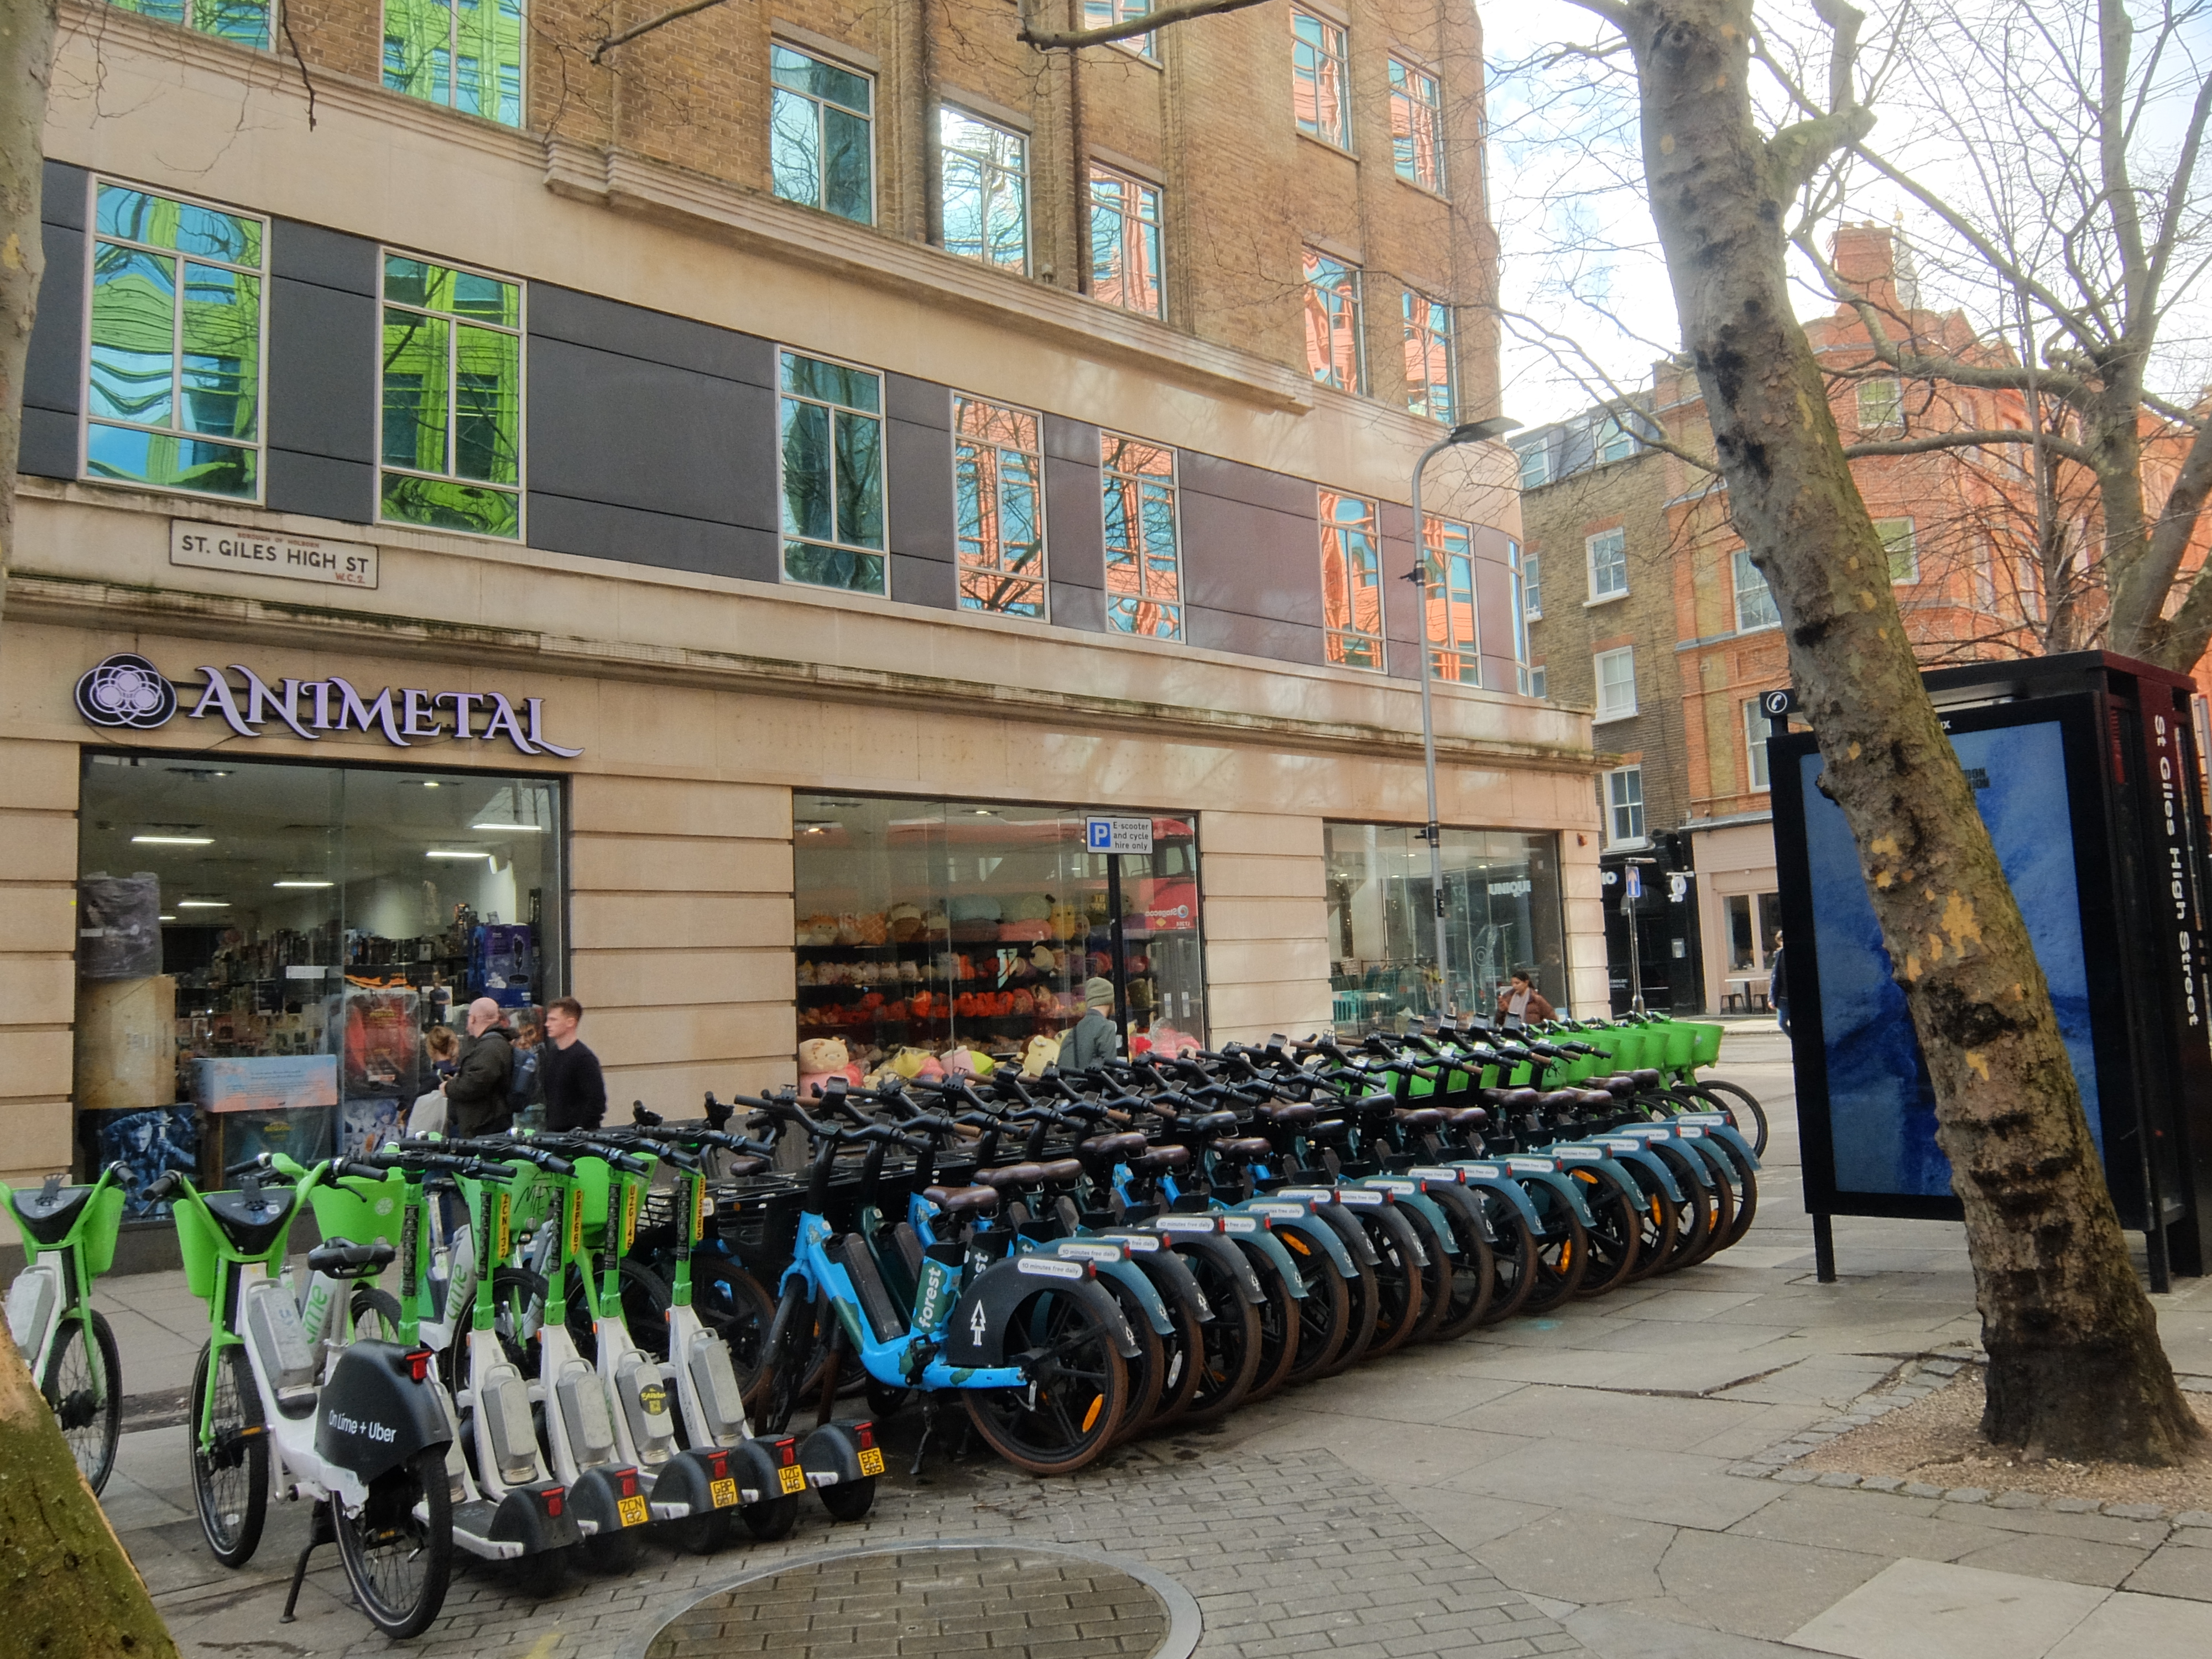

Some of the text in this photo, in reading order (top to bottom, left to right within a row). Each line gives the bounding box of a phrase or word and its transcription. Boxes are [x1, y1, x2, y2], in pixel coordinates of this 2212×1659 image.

[237, 533, 270, 542] BOROUGH
[287, 539, 320, 549] HOLBORN
[181, 535, 369, 573] ST. GILES HIGH ST
[188, 664, 585, 758] ANIMETAL
[1132, 842, 1147, 851] only
[2154, 714, 2199, 1026] St Giles High Street
[1065, 1266, 1078, 1275] daily
[919, 1267, 941, 1328] forest
[329, 1409, 337, 1427] On
[337, 1413, 358, 1434] Lime
[369, 1421, 397, 1443] Uber
[861, 1450, 880, 1464] EFS
[780, 1467, 800, 1480] UZG
[713, 1479, 733, 1494] GBP
[620, 1497, 643, 1513] ZCN
